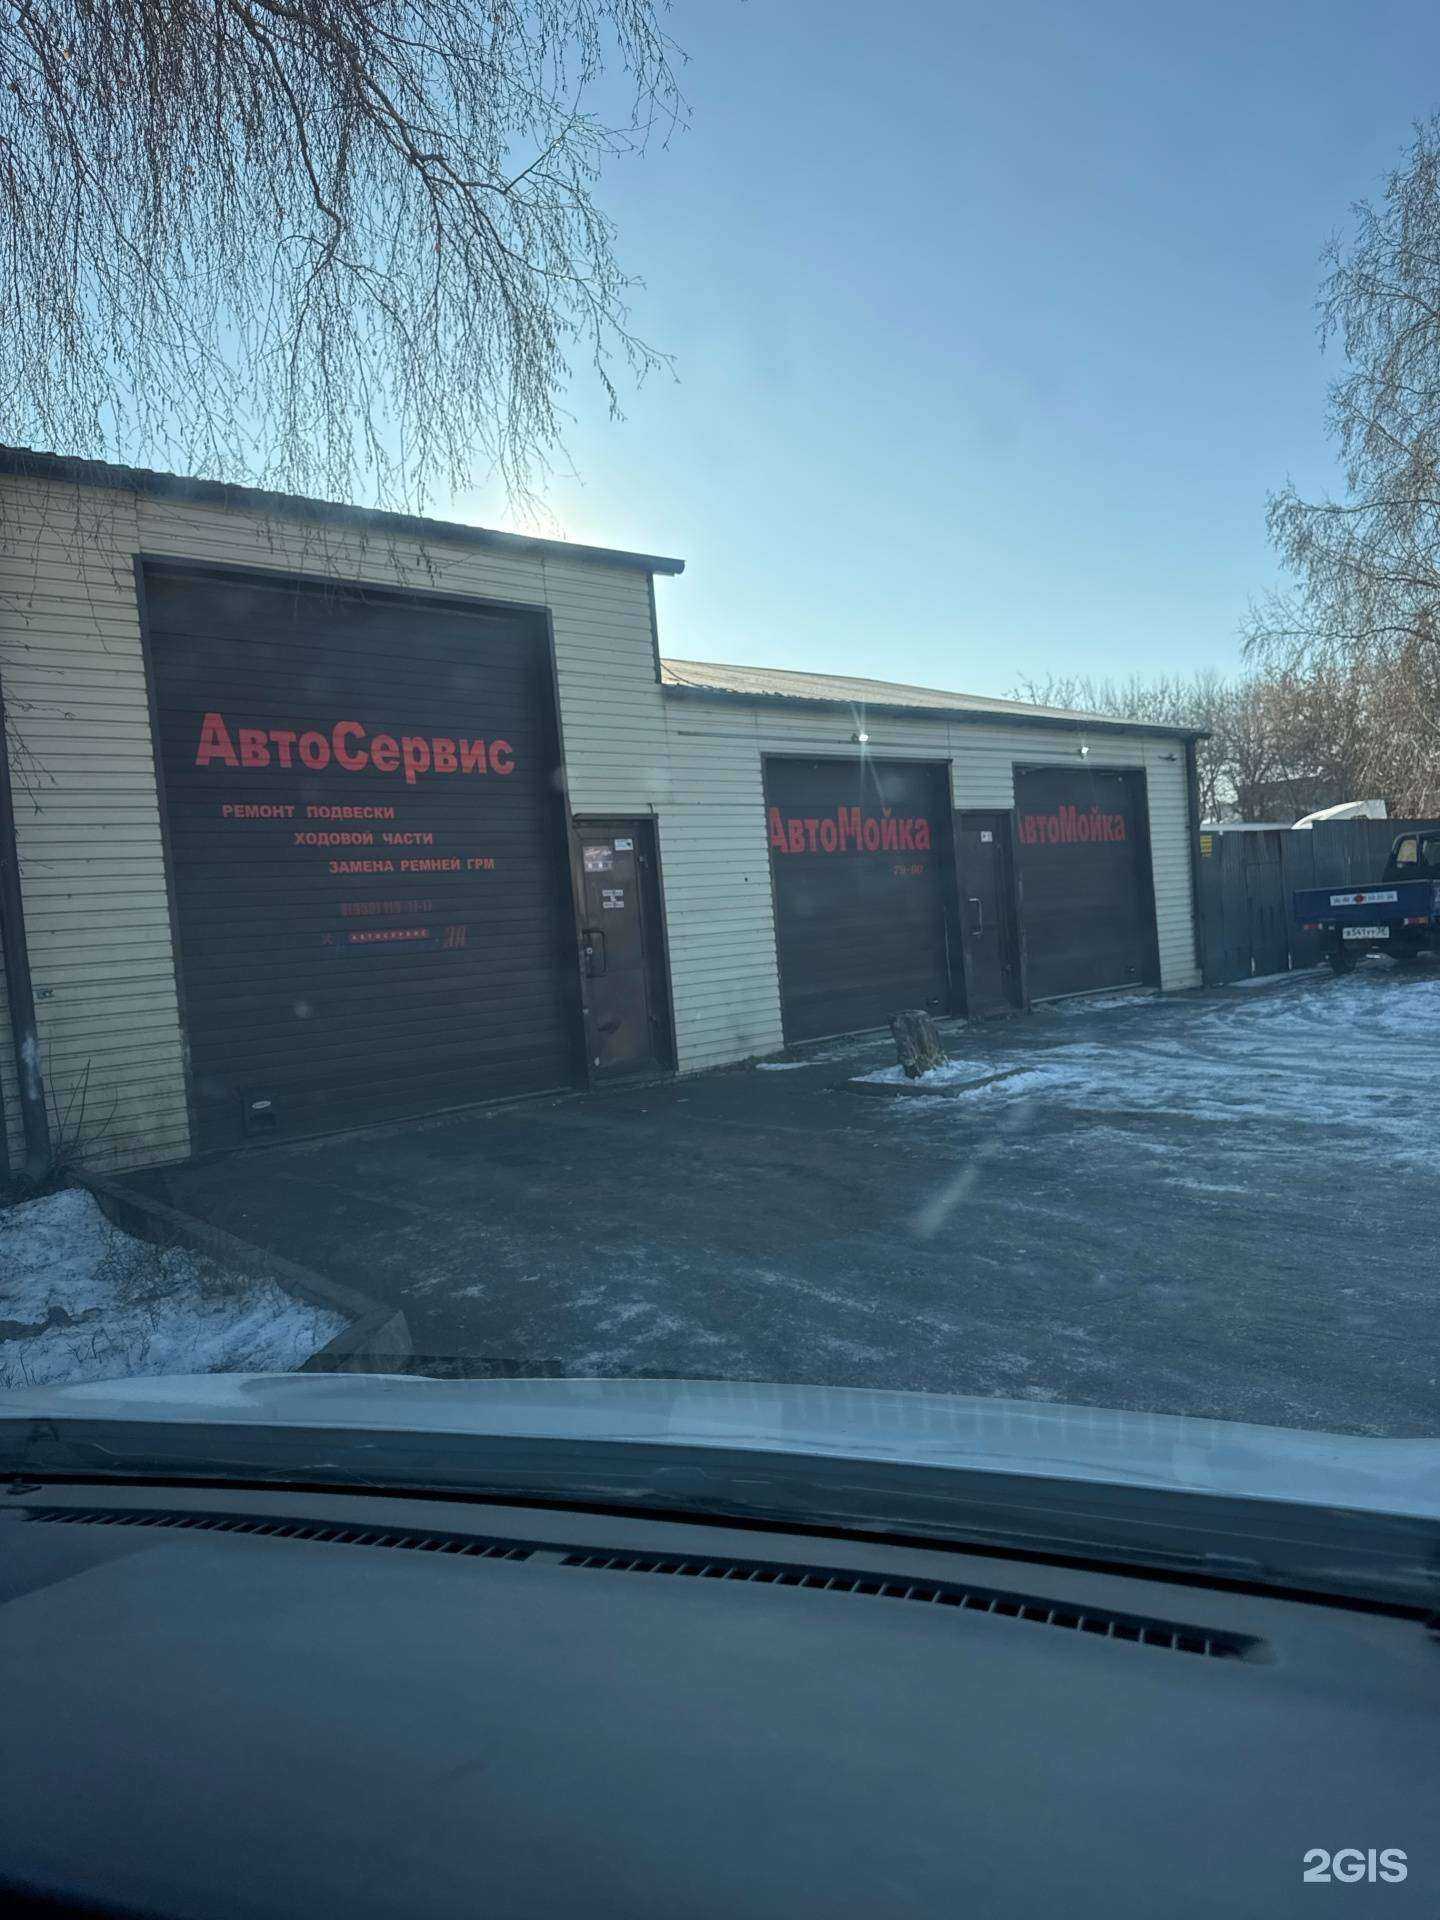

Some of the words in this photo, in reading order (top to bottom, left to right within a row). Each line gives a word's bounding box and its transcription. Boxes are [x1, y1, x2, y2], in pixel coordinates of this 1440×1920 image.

[195, 712, 516, 785] АвтоСервис
[222, 804, 296, 819] РЕМОНТ
[306, 805, 396, 820] ПОДВЕСКИ
[768, 805, 932, 853] АвтоМойка
[294, 831, 375, 846] ХОДОВОЙ
[383, 832, 435, 845] ЧАСТИ
[328, 859, 395, 874] ЗАМЕНА
[400, 857, 461, 871] РЕМНЕЙ
[467, 857, 496, 870] ГРМ
